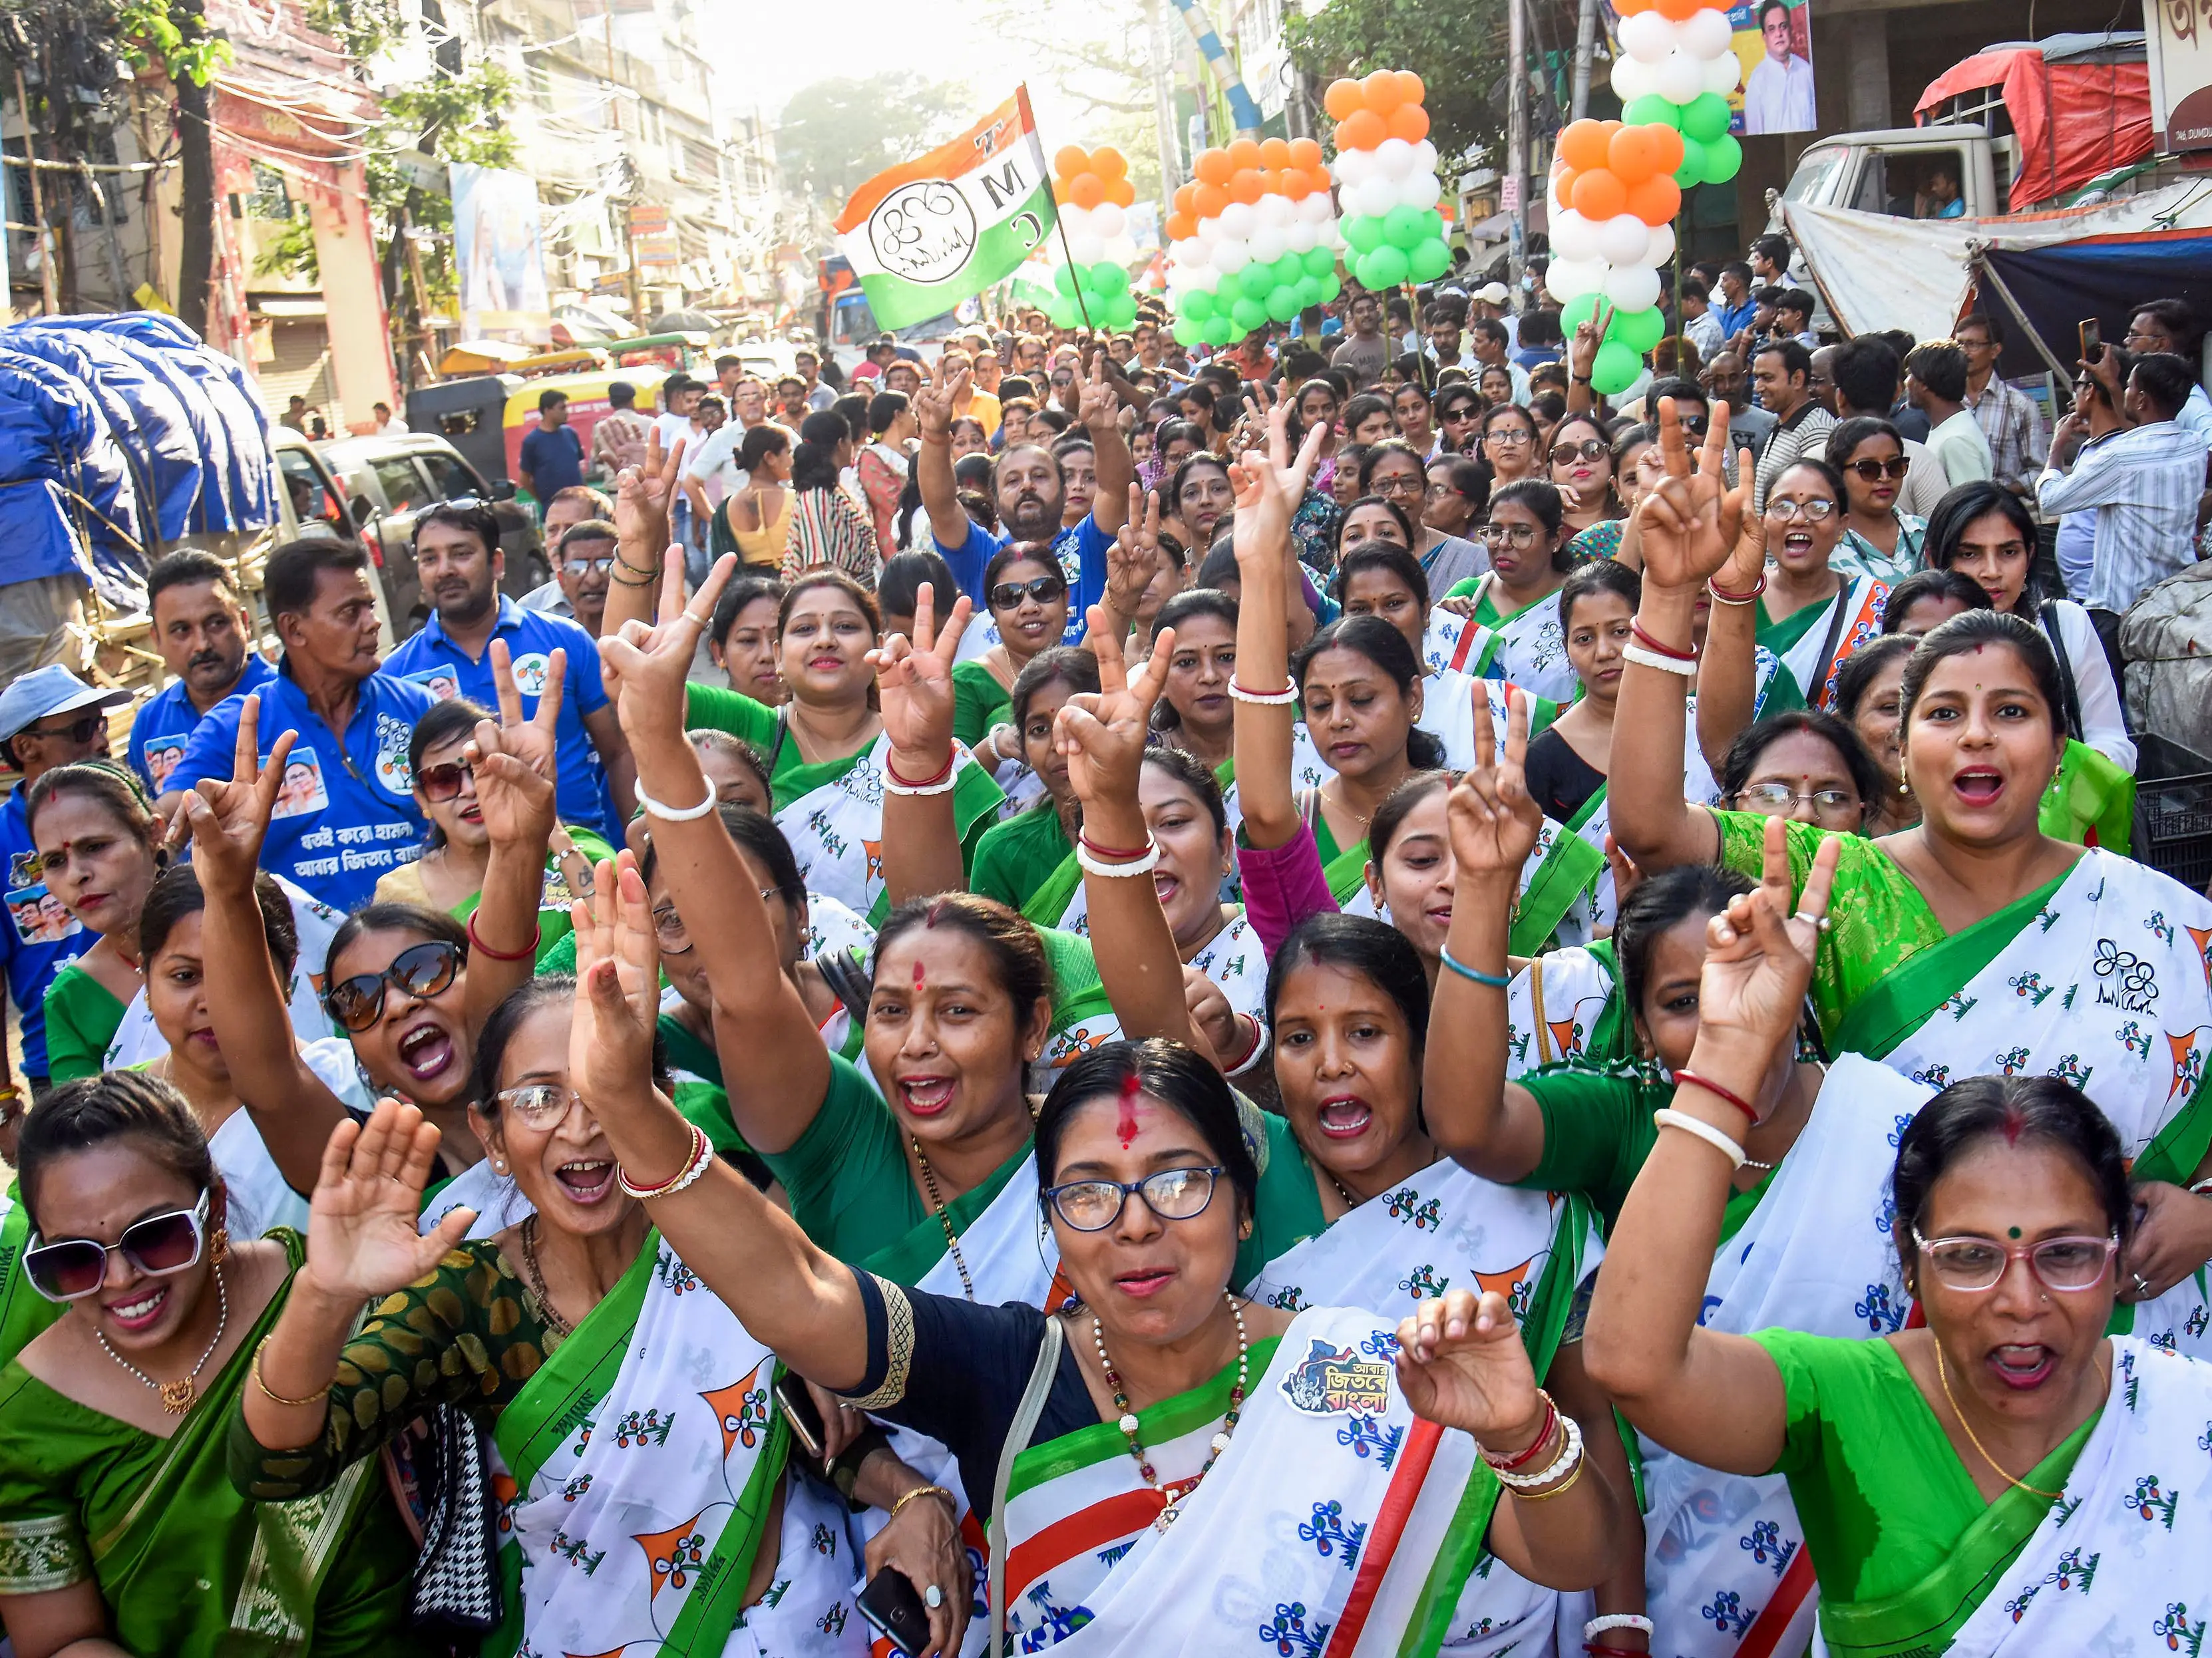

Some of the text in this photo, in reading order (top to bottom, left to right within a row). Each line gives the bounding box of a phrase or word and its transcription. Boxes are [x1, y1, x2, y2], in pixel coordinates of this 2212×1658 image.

[301, 825, 335, 850] যতই
[336, 824, 373, 844] করো
[293, 856, 339, 877] আবার
[341, 848, 393, 872] জিতবে
[1326, 1365, 1387, 1391] জিতবে
[1353, 1365, 1387, 1376] আবার
[1326, 1390, 1387, 1414] বাংলা
